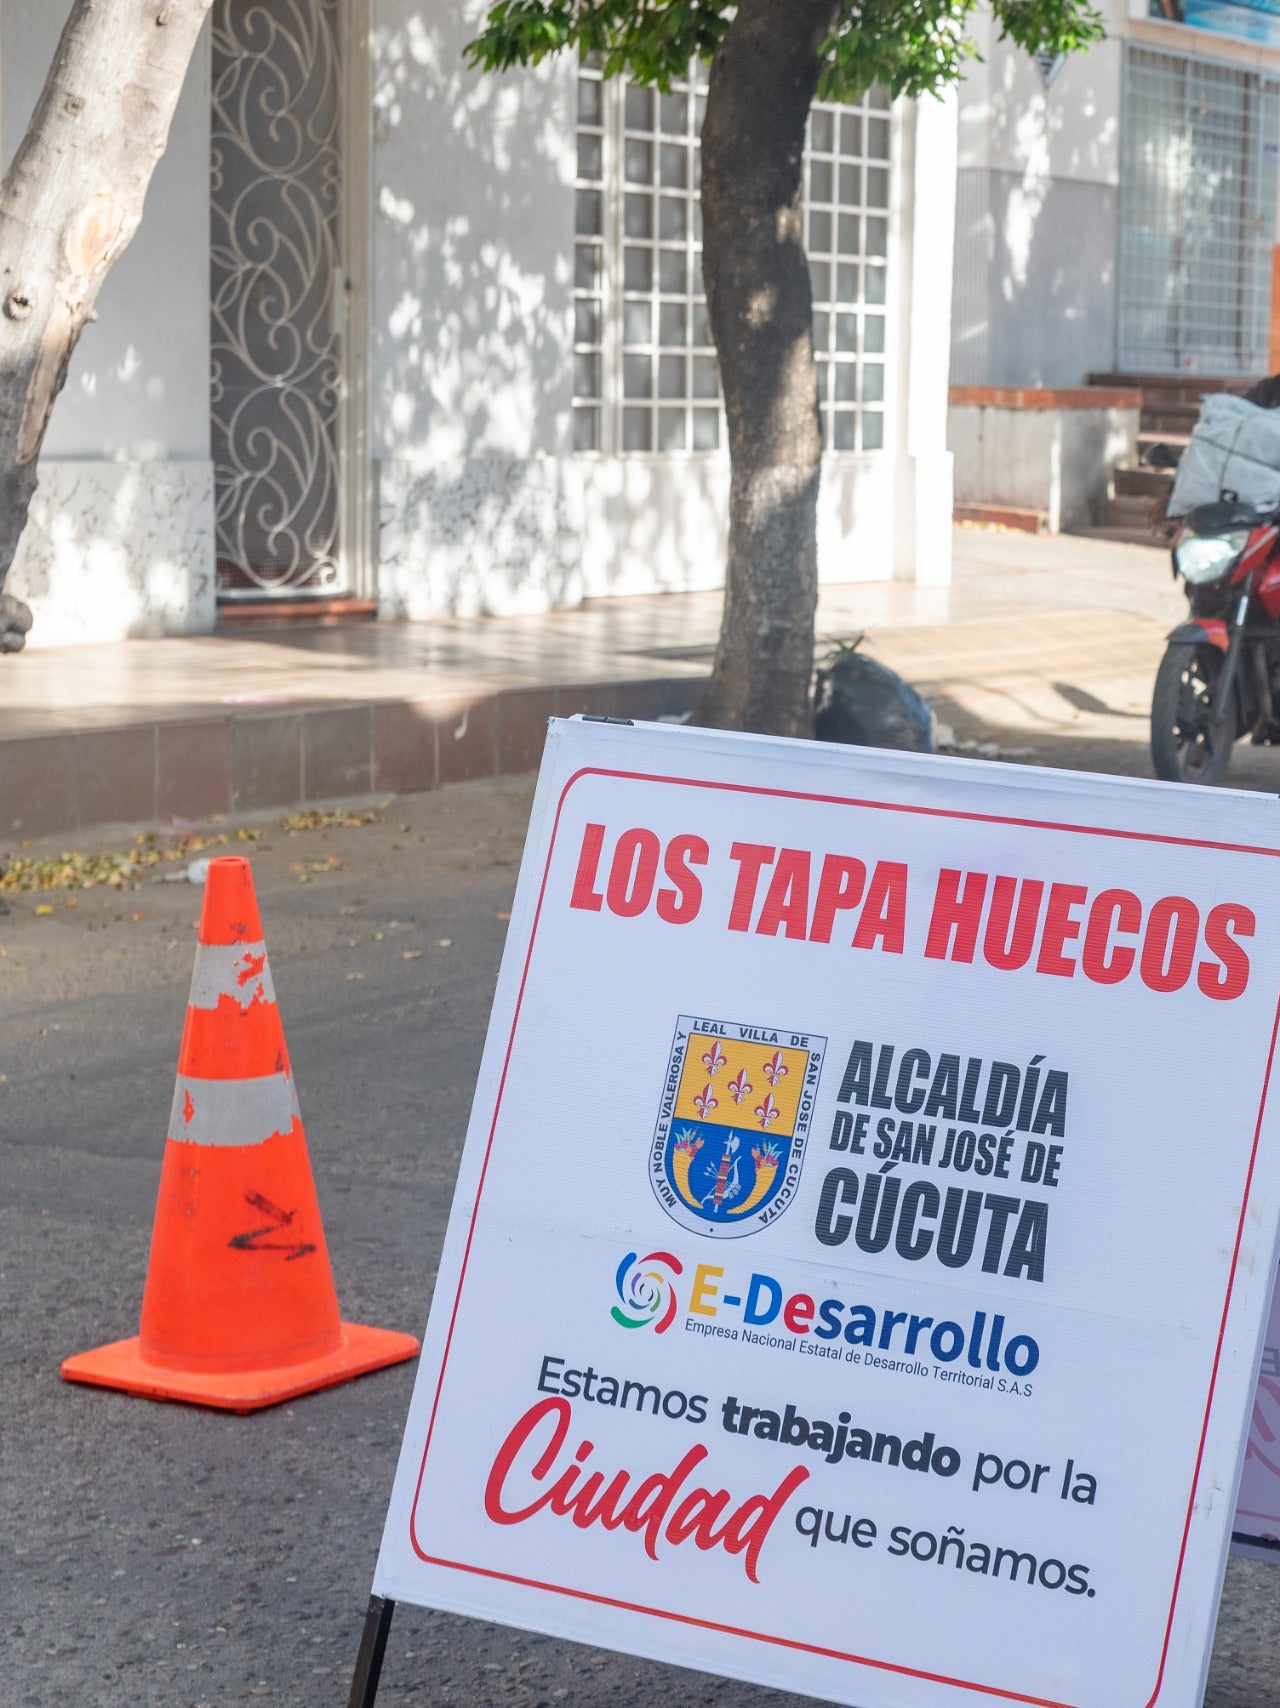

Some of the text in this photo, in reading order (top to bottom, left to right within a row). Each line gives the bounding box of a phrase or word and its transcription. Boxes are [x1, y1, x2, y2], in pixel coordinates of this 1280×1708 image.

[569, 822, 1258, 1001] LOS TAPA HUECOS
[653, 1020, 822, 1225] MUY NOBLE VALEROSA Y LEAL VILLA DE SAN JOSE DE CUCUTA
[829, 1109, 1064, 1188] DE SAN JOSÉ DE
[836, 1039, 1069, 1138] ALCALDÍA
[814, 1160, 1049, 1283] CÚCUTA
[685, 1318, 1033, 1397] Empresa Nacional Estatal de Desarrollo Territorial S.A.S
[688, 1263, 1040, 1377] E-Desarrollo
[537, 1355, 1097, 1506] Estamos trabajando por la
[484, 1396, 1096, 1598] Ciudad que soñamos.
